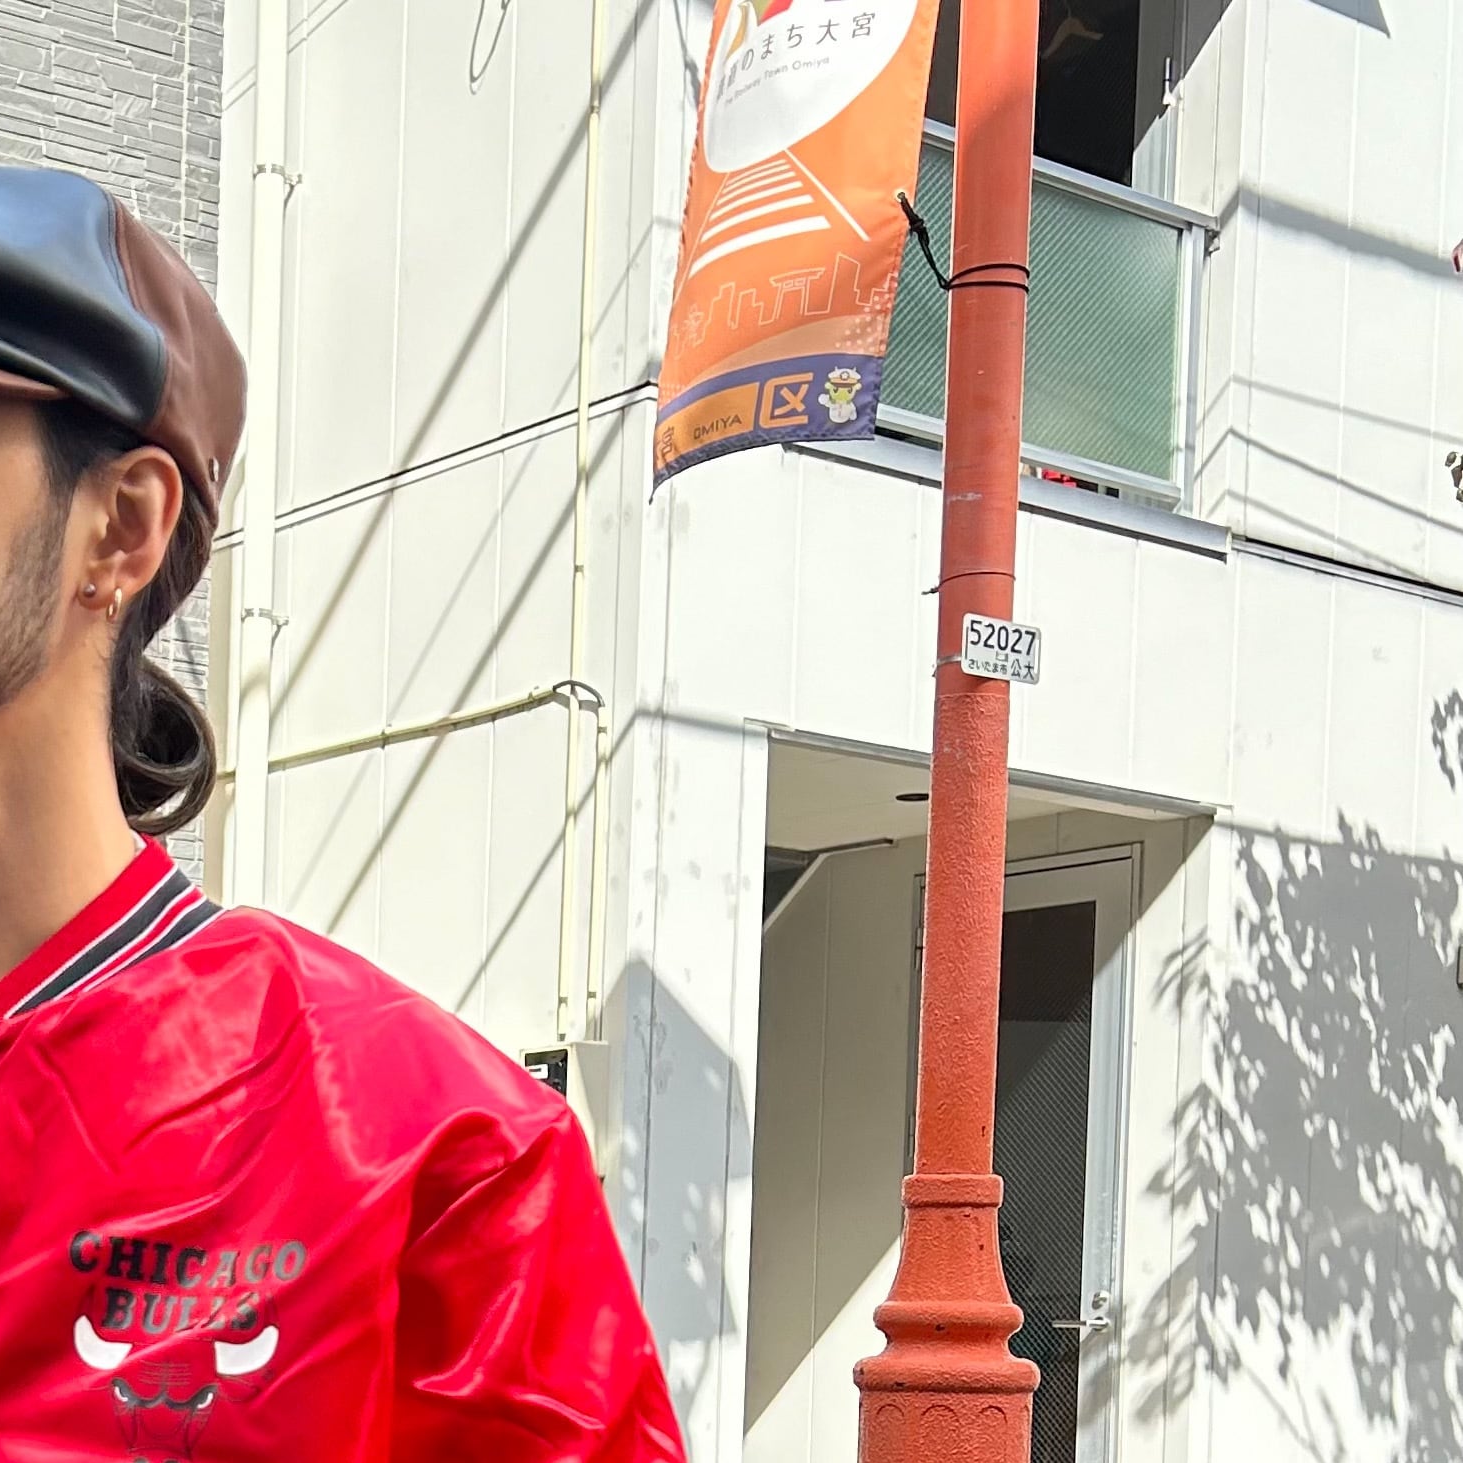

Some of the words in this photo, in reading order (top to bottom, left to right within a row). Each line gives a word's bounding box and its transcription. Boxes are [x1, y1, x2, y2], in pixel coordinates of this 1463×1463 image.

[792, 57, 830, 71] Omiya
[759, 372, 814, 429] 区
[693, 414, 742, 440] OMIYA
[970, 620, 1036, 656] 52027
[968, 658, 1008, 675] さいたま市
[69, 1230, 307, 1288] CHICAGO
[101, 1287, 260, 1334] BULLS
